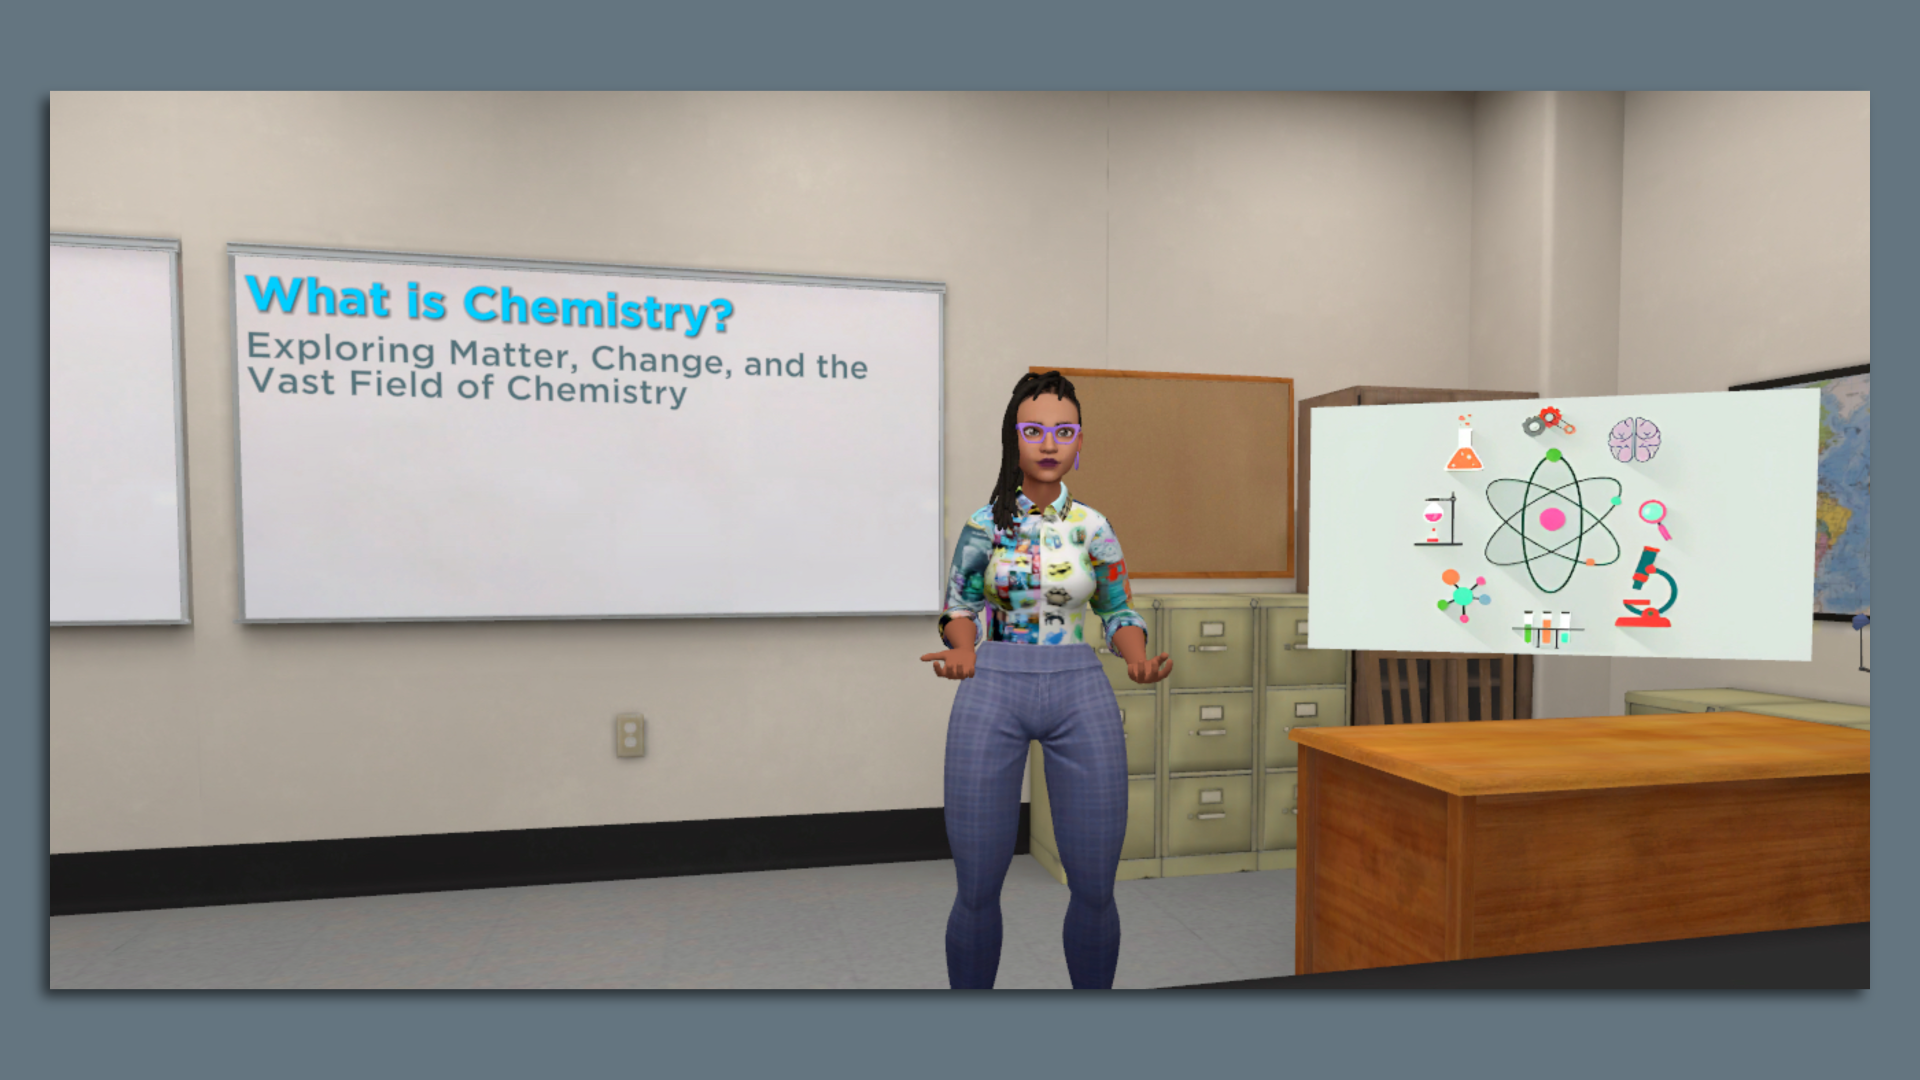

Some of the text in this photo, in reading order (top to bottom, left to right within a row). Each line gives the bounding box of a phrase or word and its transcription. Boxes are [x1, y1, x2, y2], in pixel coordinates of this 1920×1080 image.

[244, 274, 733, 337] What is Chemistry?
[247, 331, 868, 380] Exploring Matter, Change, and the
[247, 366, 687, 410] Vast Field of Chemistry
